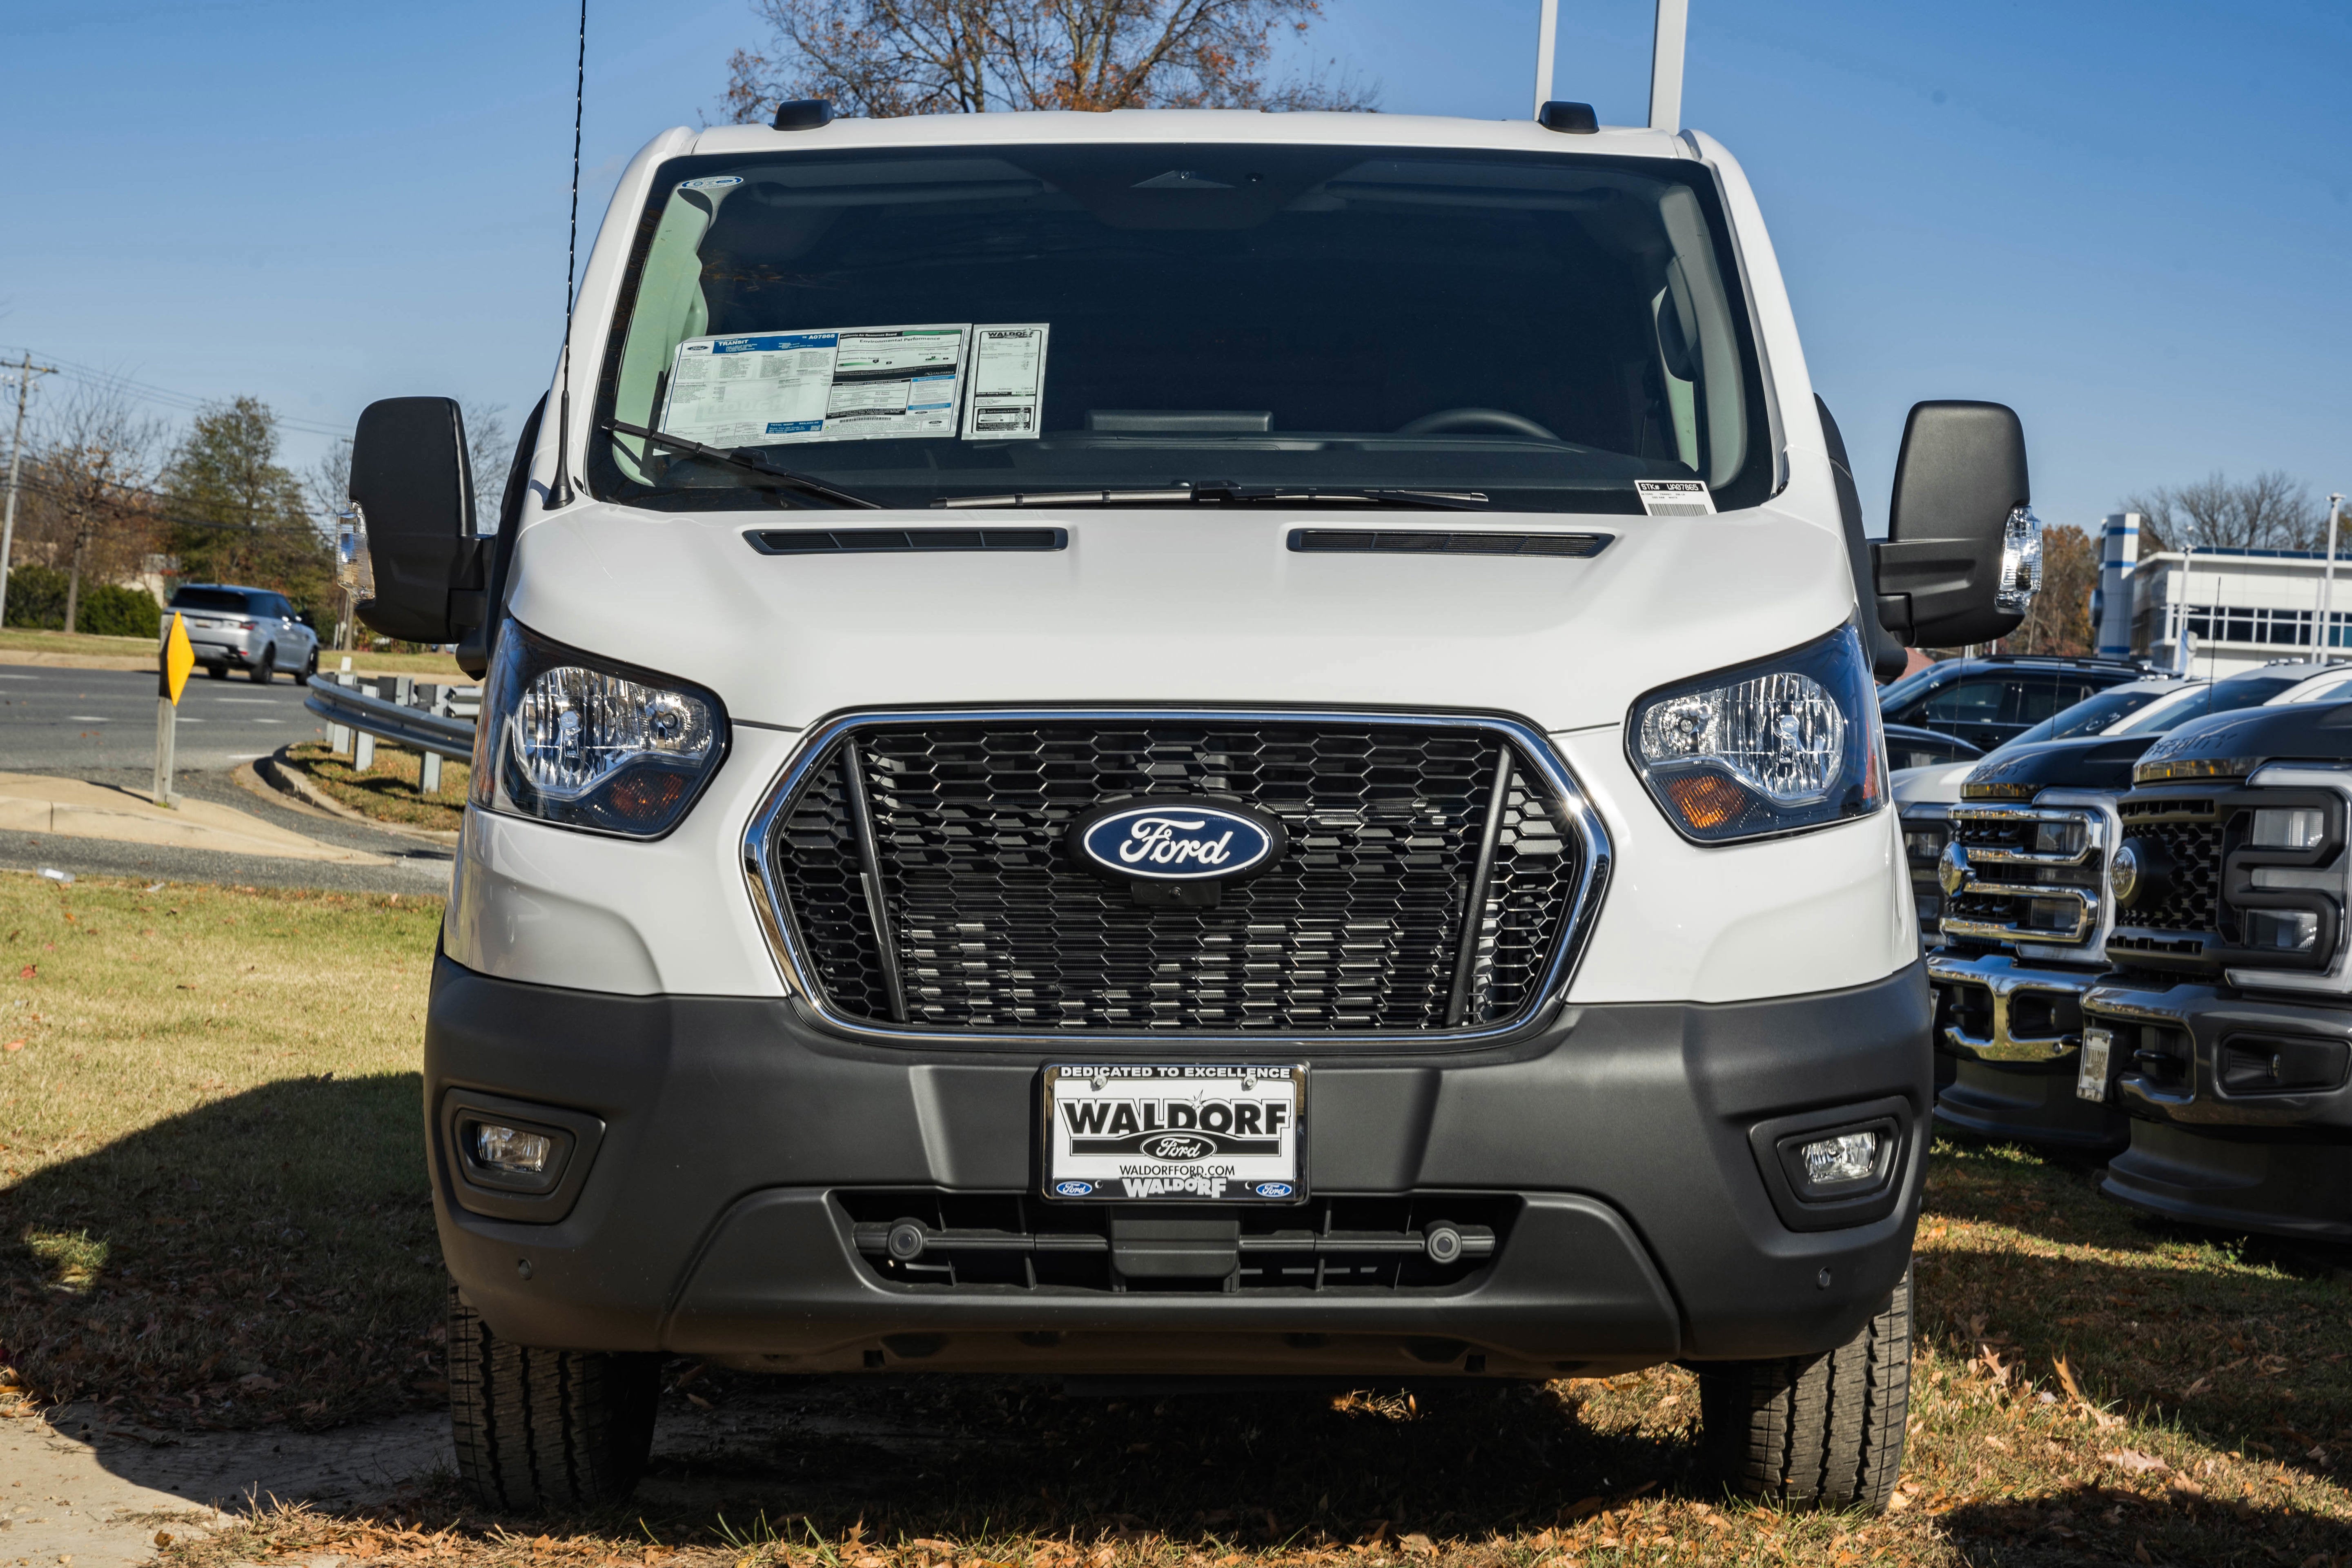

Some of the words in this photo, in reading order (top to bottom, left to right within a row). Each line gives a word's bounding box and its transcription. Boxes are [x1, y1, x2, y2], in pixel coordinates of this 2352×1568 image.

[1120, 817, 1234, 864] Ford
[2085, 1047, 2107, 1067] WALDOR
[1061, 1067, 1152, 1077] DEDICATED
[1161, 1067, 1179, 1077] TO
[1184, 1067, 1290, 1078] EXCELLENCE
[1063, 1103, 1287, 1135] WALDORF
[1156, 1137, 1201, 1158] Ford
[1120, 1165, 1235, 1176] WALDORFFORD.COM
[1061, 1183, 1086, 1195] Ford
[1122, 1177, 1227, 1198] WALDORF
[1261, 1184, 1286, 1196] Ford
